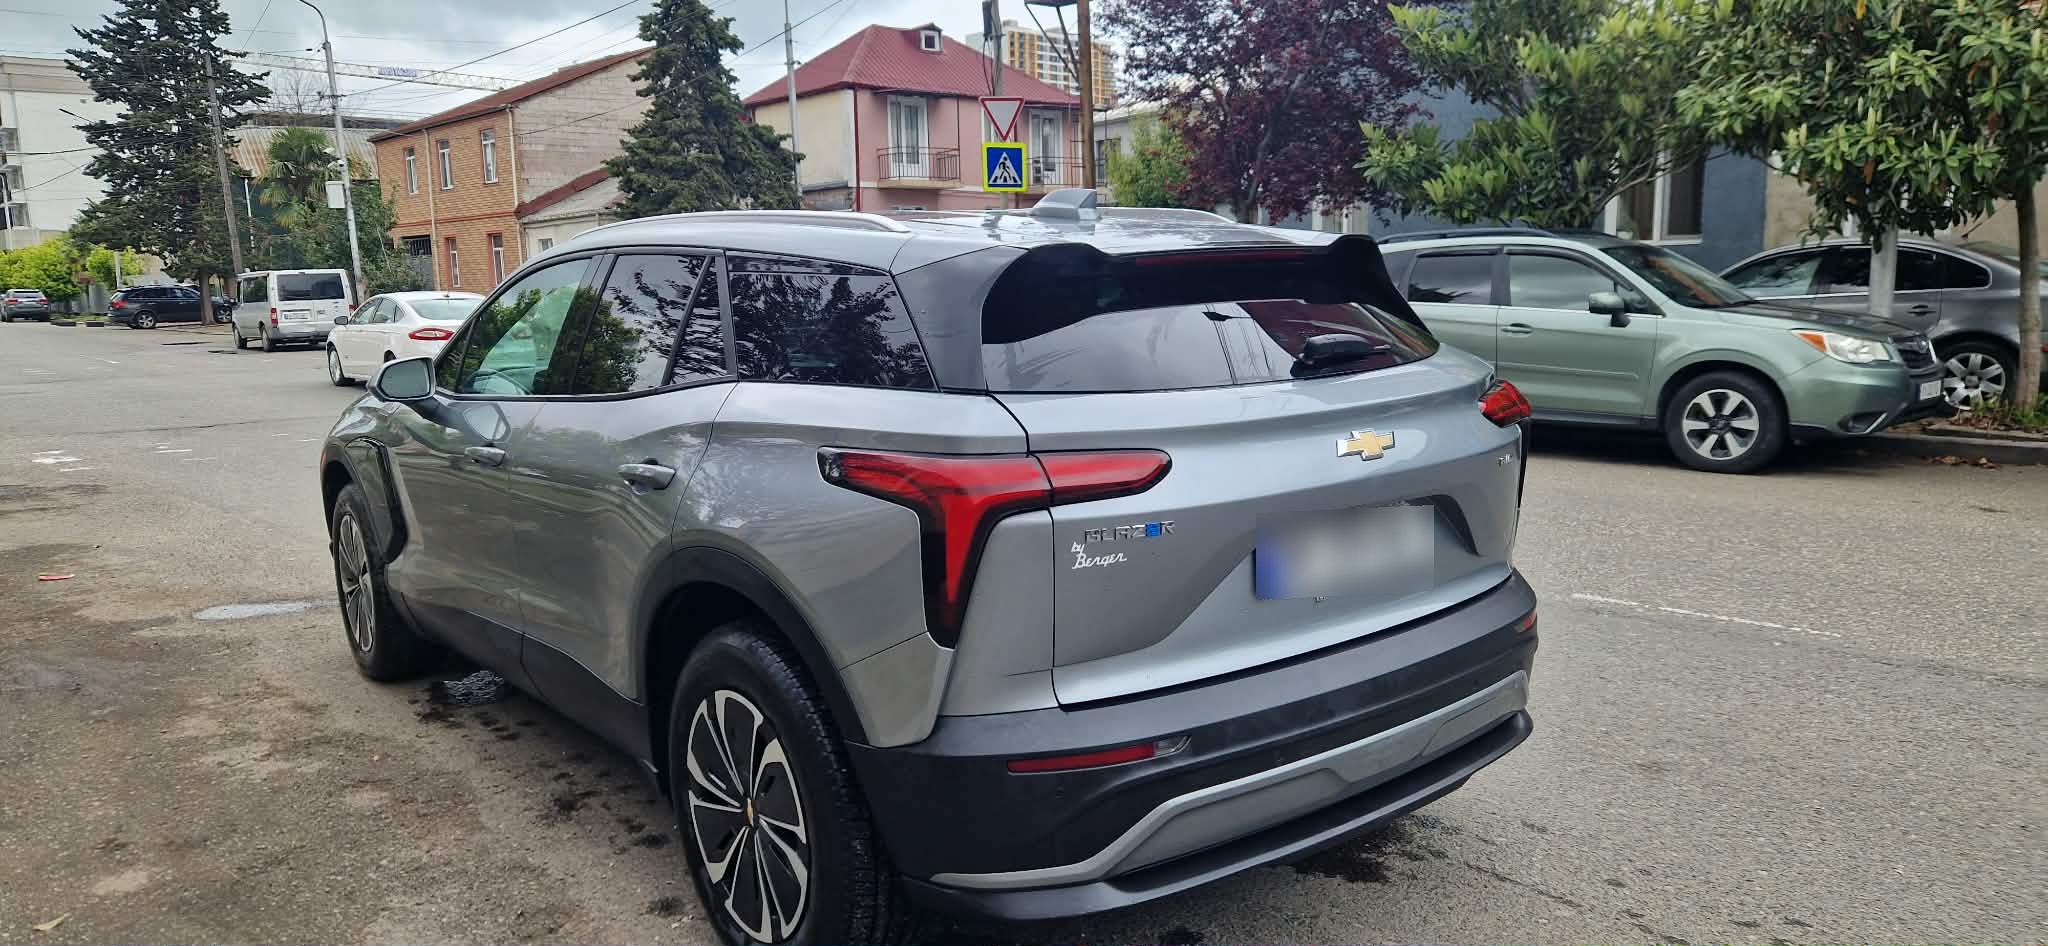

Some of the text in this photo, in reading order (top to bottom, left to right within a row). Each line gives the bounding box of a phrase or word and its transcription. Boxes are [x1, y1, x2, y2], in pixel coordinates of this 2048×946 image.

[1084, 520, 1176, 542] BLAZER
[1071, 541, 1085, 554] by
[1071, 552, 1127, 570] Berger
